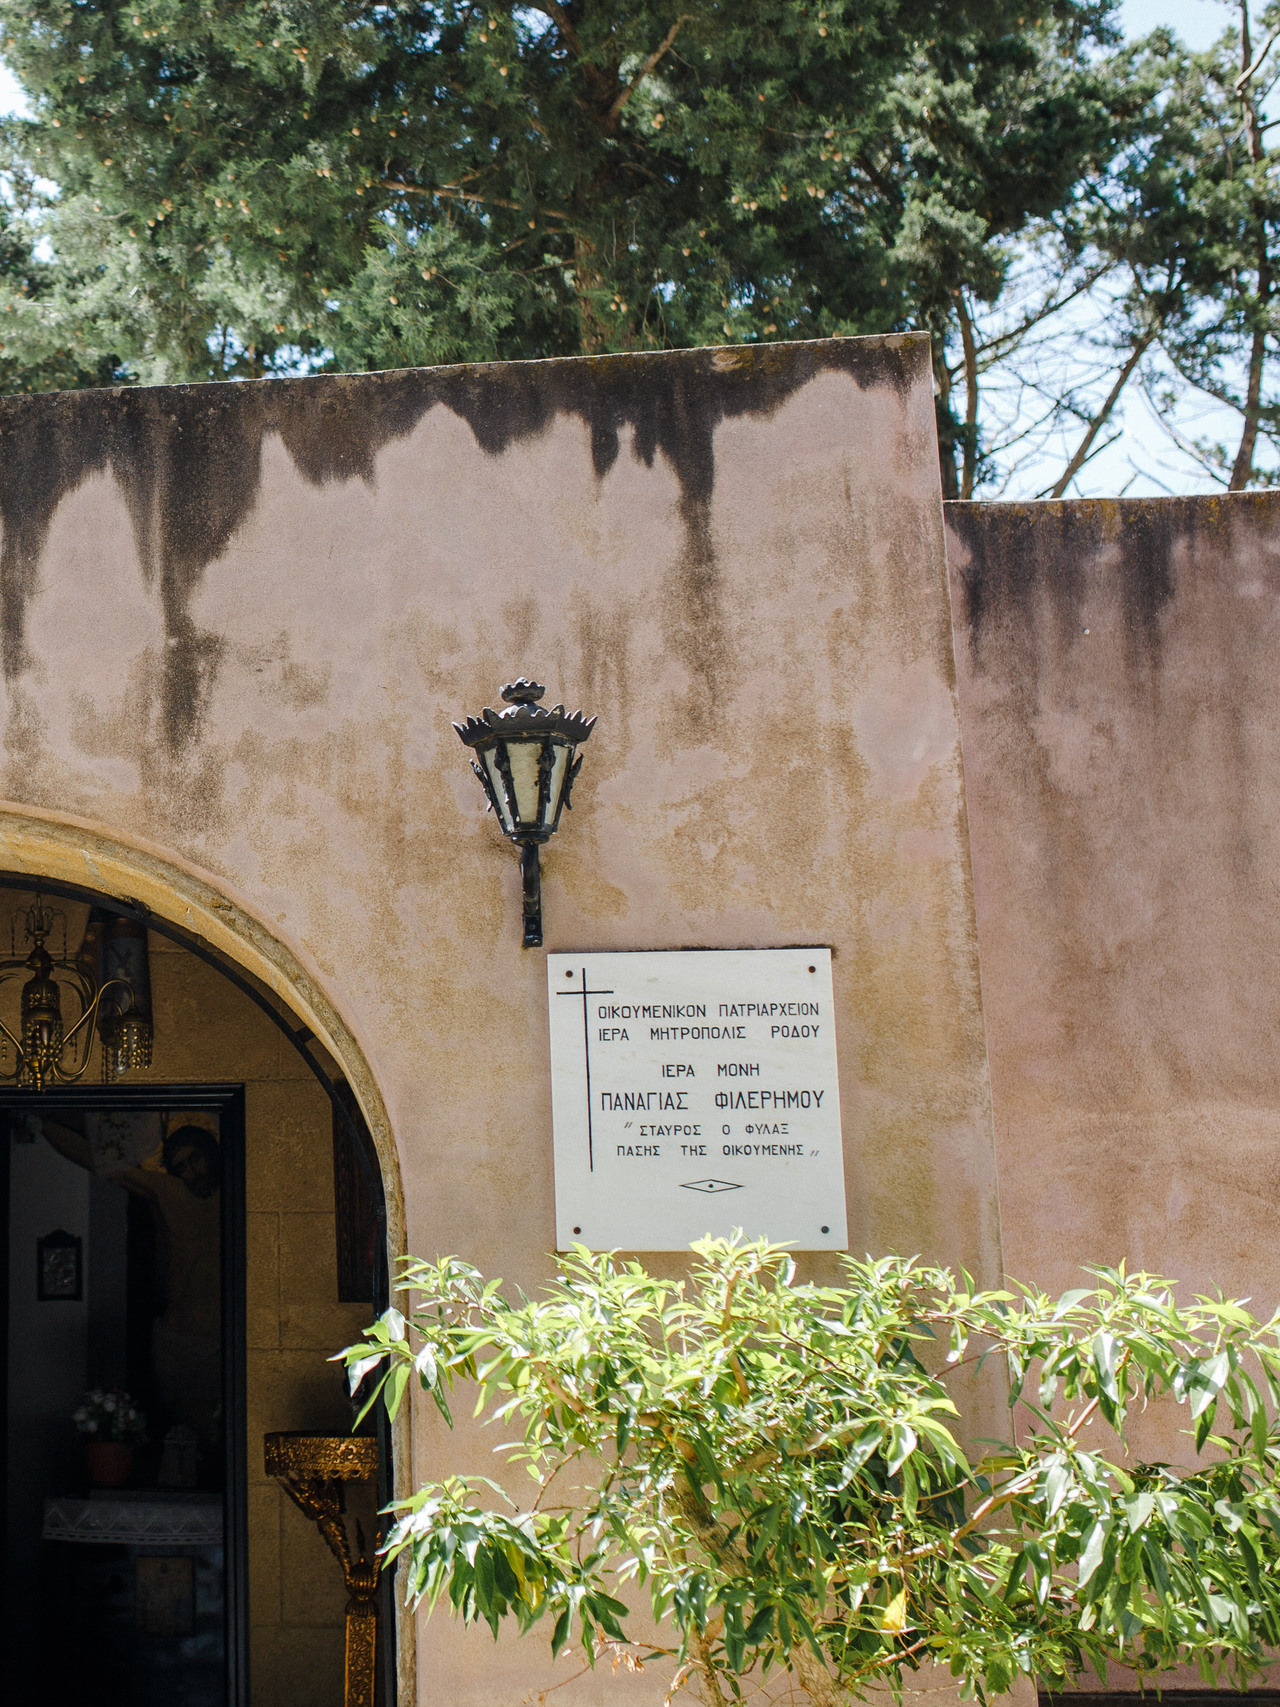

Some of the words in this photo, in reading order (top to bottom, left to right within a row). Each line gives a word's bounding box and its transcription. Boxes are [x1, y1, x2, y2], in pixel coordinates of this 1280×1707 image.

[598, 1004, 706, 1019] ΟΙΚΟΥΜΕΝΙΚΟΝ
[719, 1002, 820, 1017] ΠΑΤΡΙΑΡΧΕΙΟΝ
[599, 1028, 630, 1041] ΙΕΡΑ
[650, 1026, 746, 1040] ΜΗΤΡΟΠΟΛΙΣ
[771, 1025, 820, 1038] ΡΟΔΟΥ
[662, 1064, 695, 1078] ΙΕΡΑ
[717, 1063, 760, 1076] ΜΟΝΗ
[601, 1092, 688, 1111] ΠΑΝΑΓΙΑΣ
[714, 1090, 824, 1109] ΦΙΛΕΡΗΜΟΥ
[722, 1124, 731, 1135] Ο
[745, 1124, 789, 1134] ΦΥΛΑΞ
[617, 1145, 660, 1156] ΠΑΣΗΣ
[680, 1145, 707, 1156] ΤΗΣ
